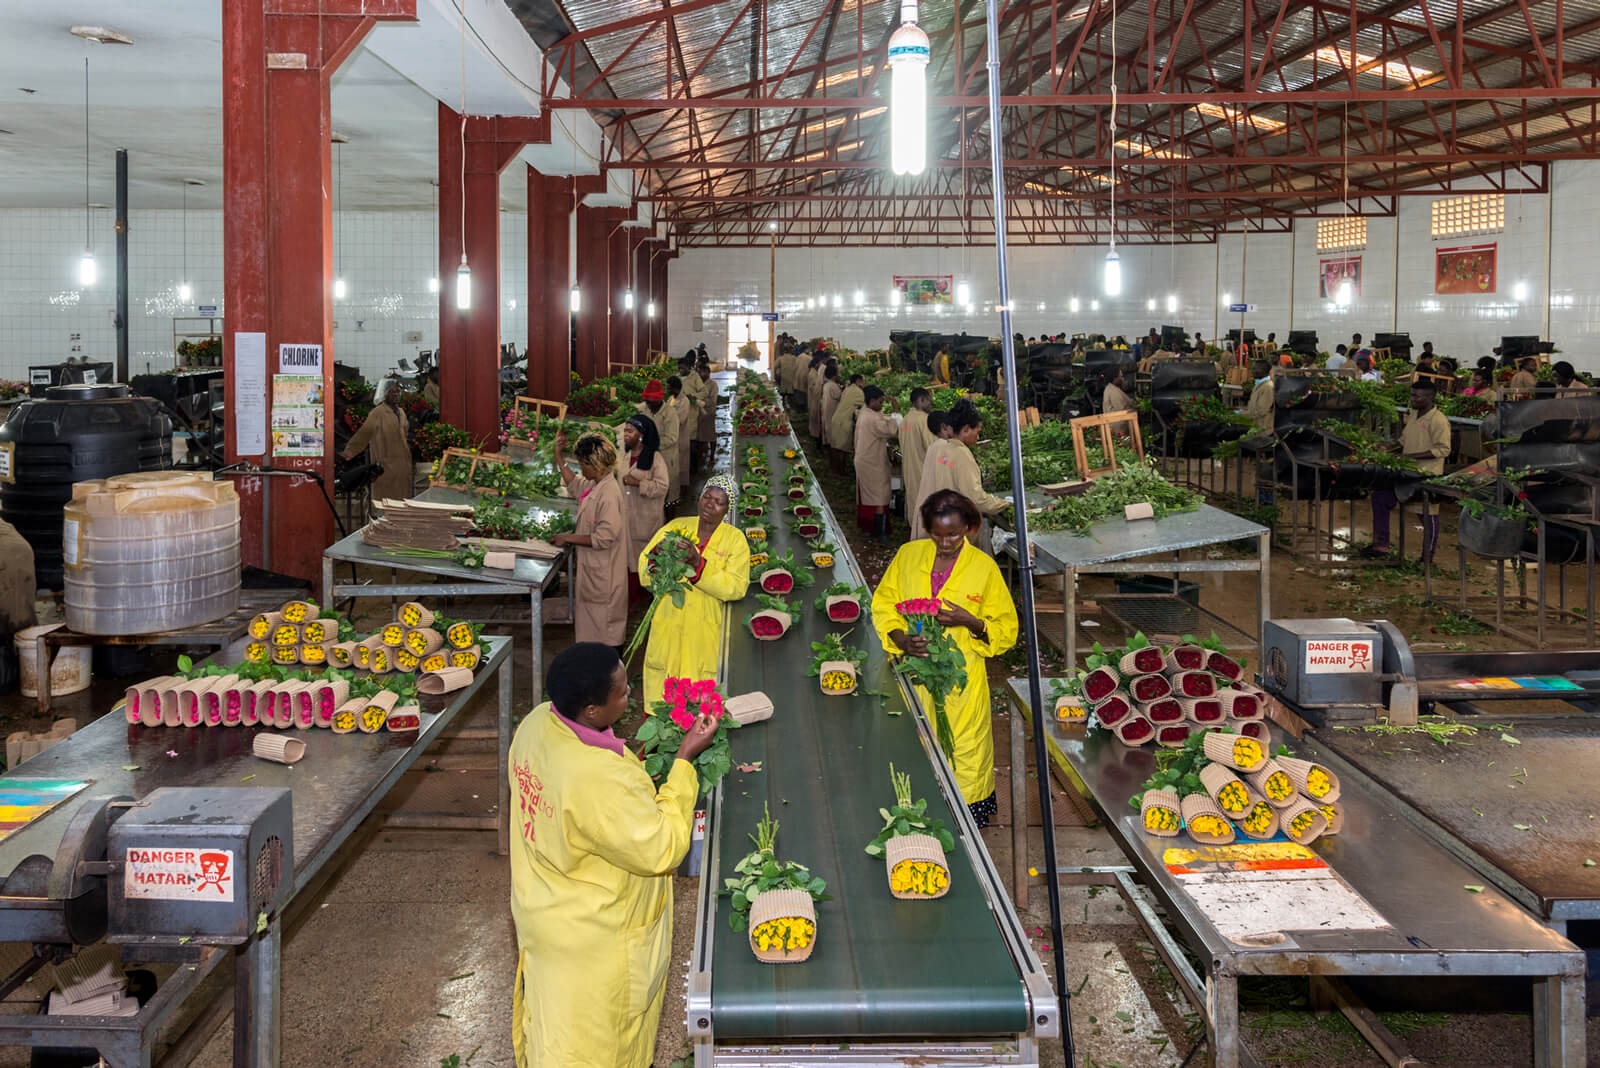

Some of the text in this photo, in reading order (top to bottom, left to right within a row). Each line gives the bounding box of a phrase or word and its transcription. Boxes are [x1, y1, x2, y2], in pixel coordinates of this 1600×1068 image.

[282, 347, 319, 366] CHLORINE
[1308, 643, 1349, 651] DANGER
[1310, 656, 1346, 664] HATARI
[129, 850, 195, 864] DANGER
